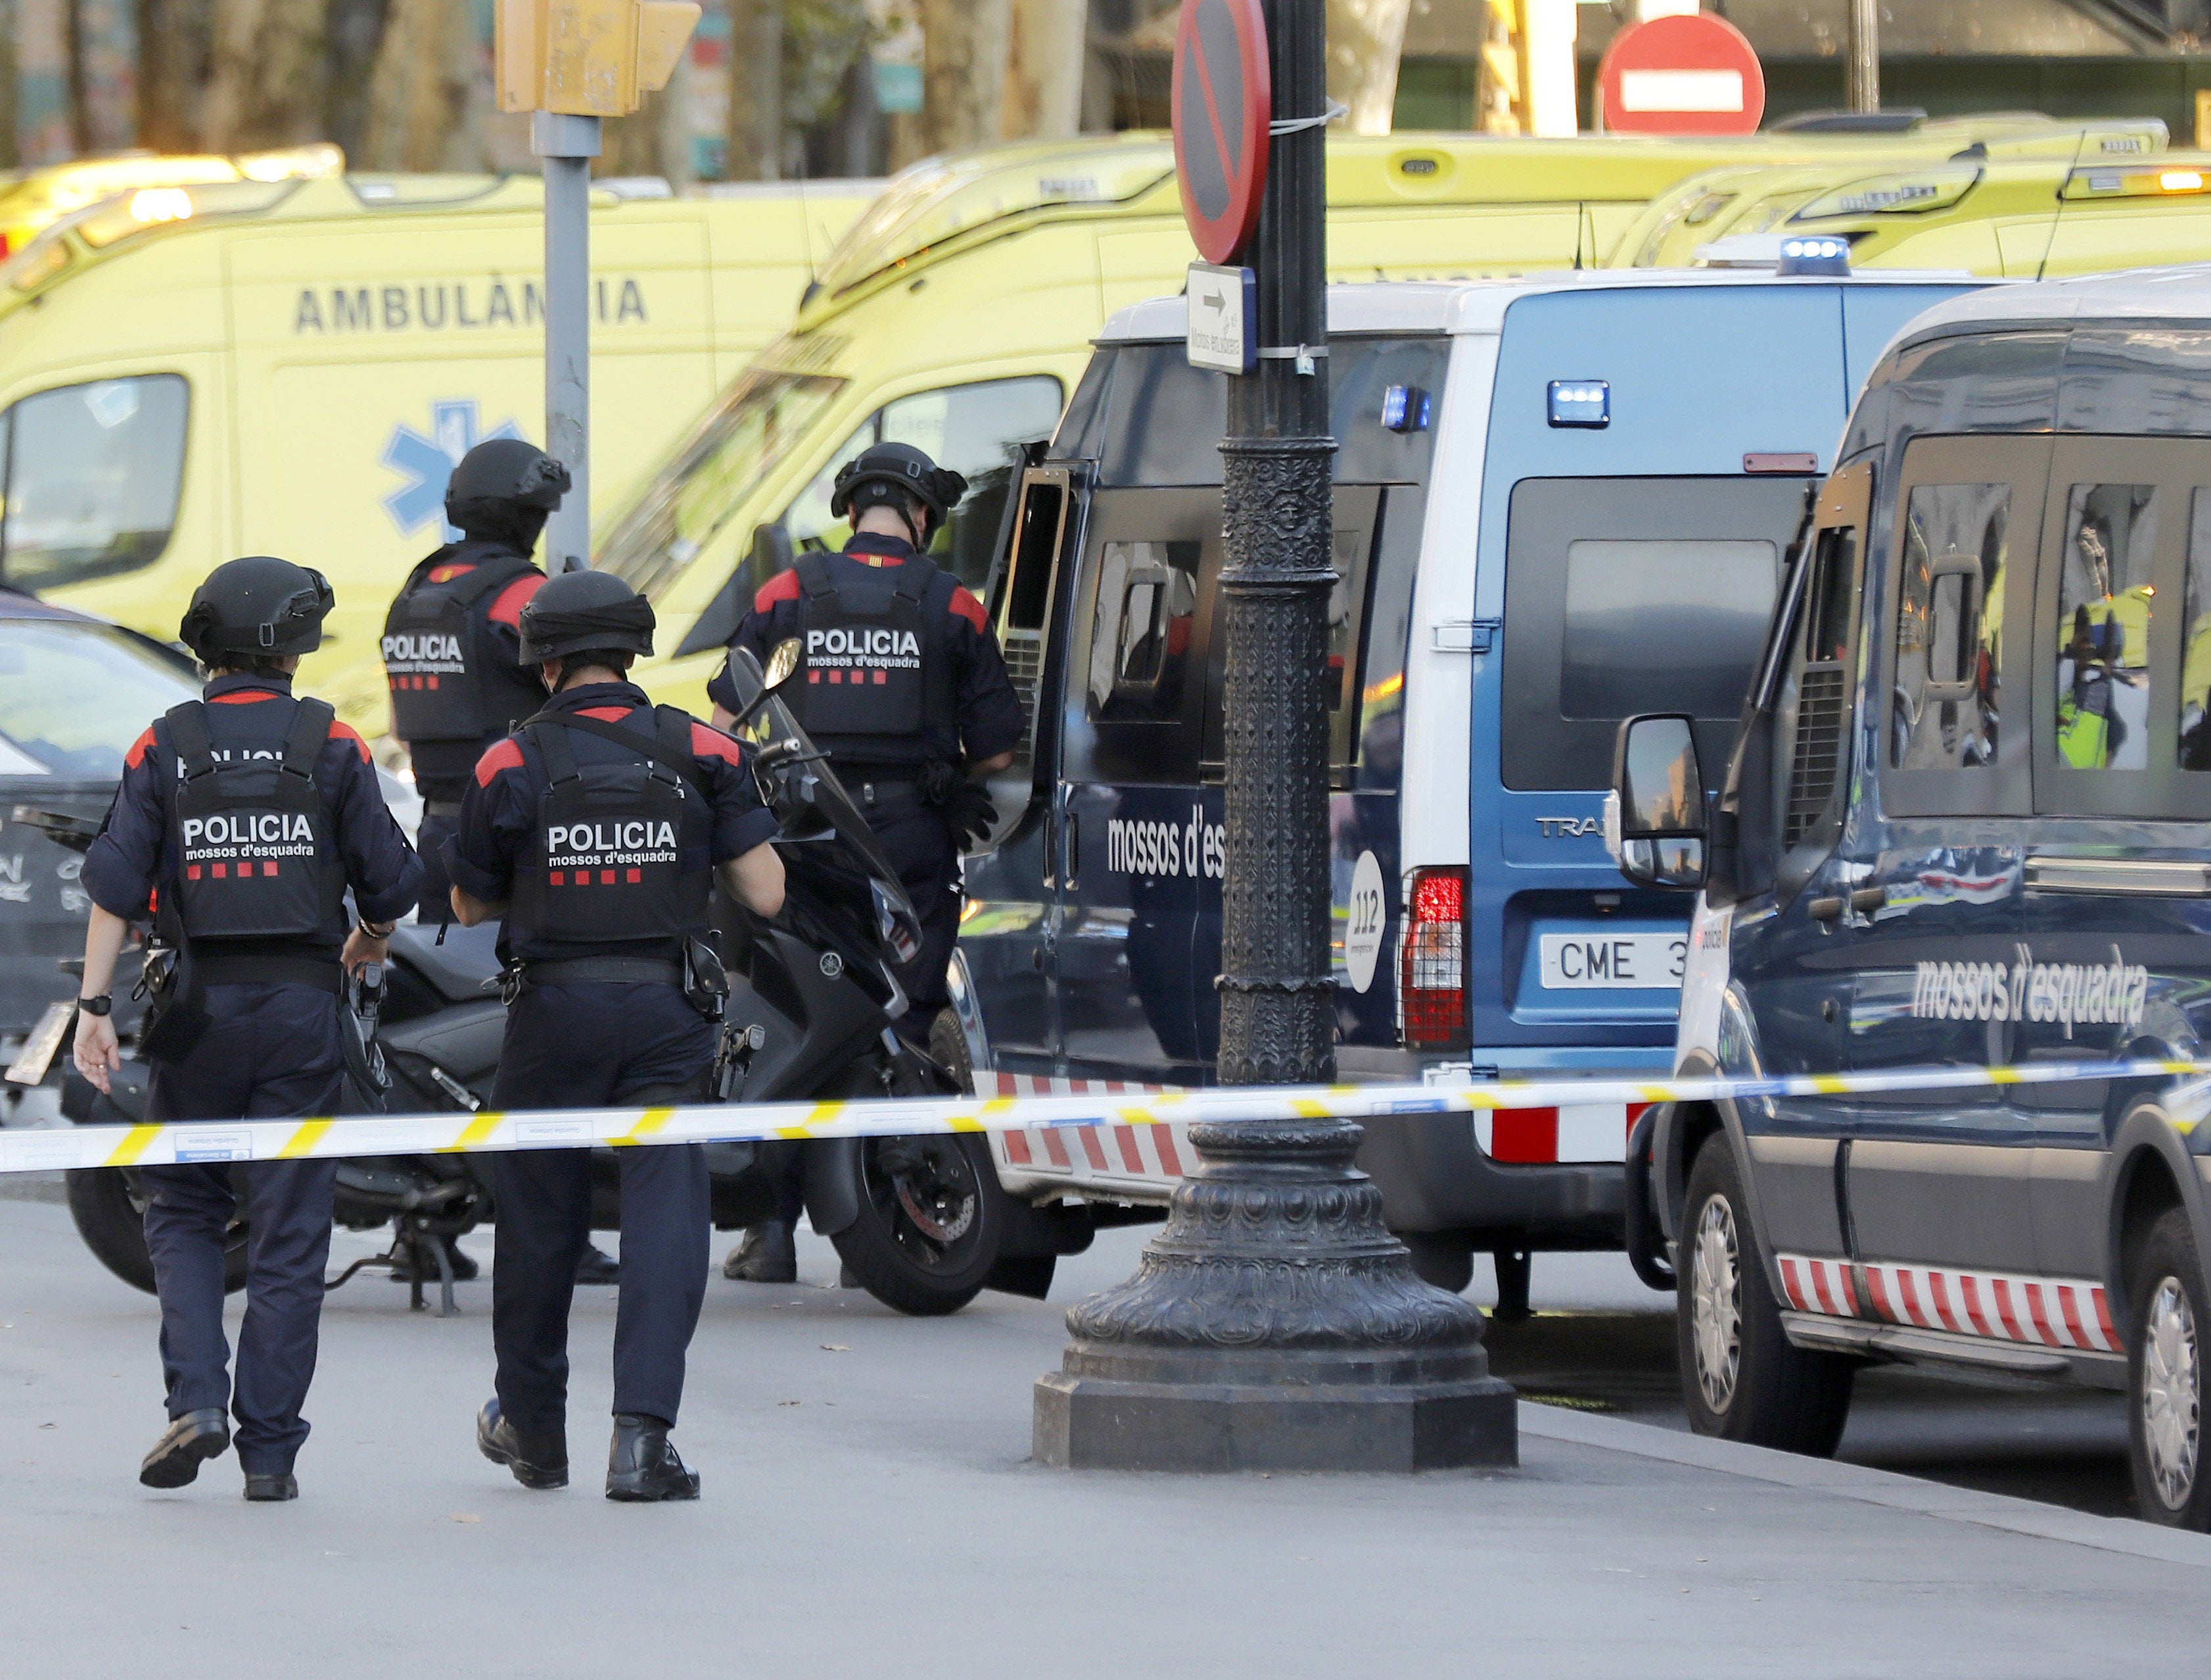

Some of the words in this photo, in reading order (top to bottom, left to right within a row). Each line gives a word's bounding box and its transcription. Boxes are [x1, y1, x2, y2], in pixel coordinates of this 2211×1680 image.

[297, 269, 646, 331] AMBULÀNIA
[381, 634, 463, 661] POLICIA
[806, 628, 920, 656] POLICIA
[807, 657, 852, 667] mossos
[855, 655, 920, 670] d'esquadra
[183, 814, 314, 847] POLICIA
[548, 822, 677, 853] POLICIA
[1108, 819, 1180, 877] mossos
[1184, 803, 1226, 879] d'es
[1535, 816, 1605, 838] TRA
[185, 847, 237, 860] mossos
[241, 843, 314, 860] d'esquadra
[548, 855, 601, 867] mossos
[605, 850, 676, 866] d'esquadra
[1353, 889, 1378, 935] 112
[1561, 942, 1636, 980] CME
[1669, 941, 1687, 977] 3
[1912, 961, 2010, 1023] mossos
[2011, 942, 2148, 1040] d'esquadra
